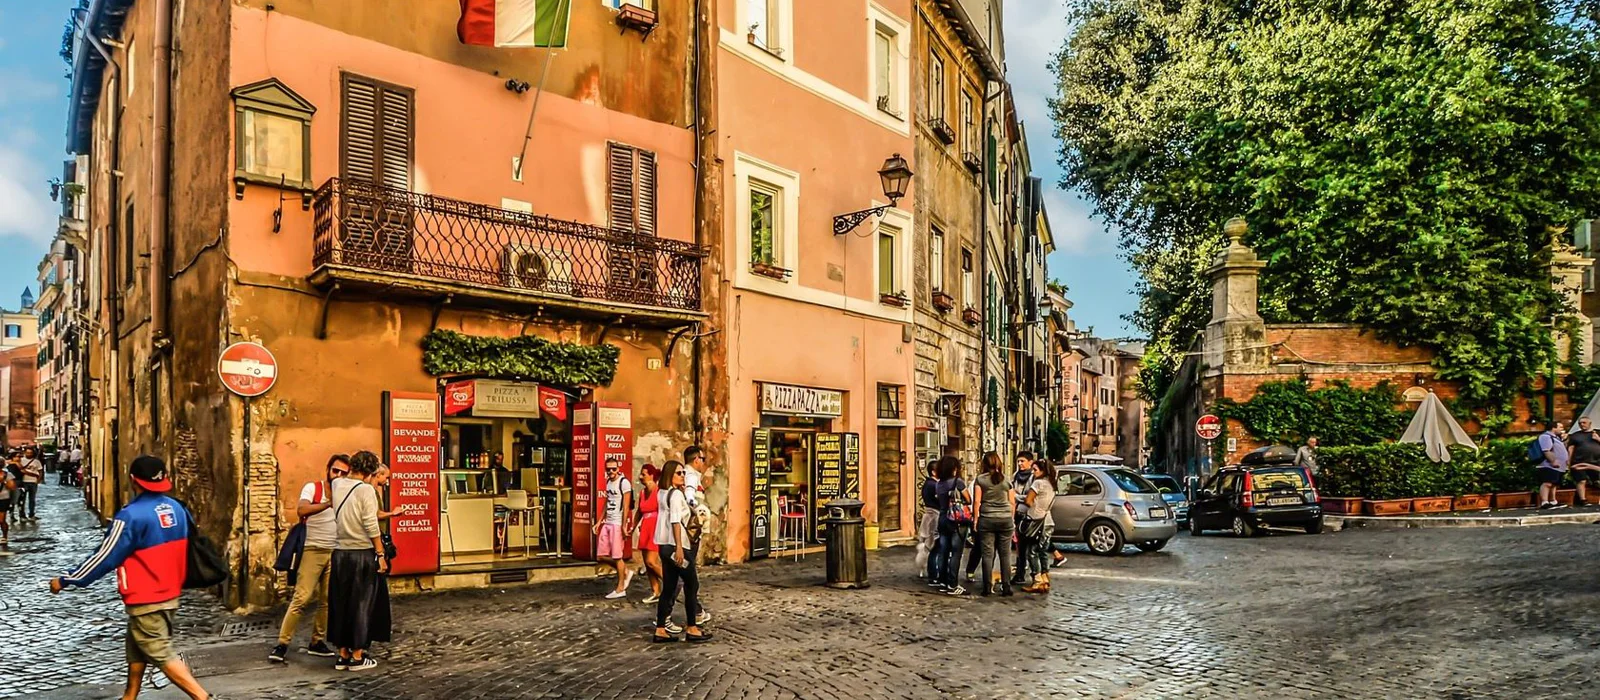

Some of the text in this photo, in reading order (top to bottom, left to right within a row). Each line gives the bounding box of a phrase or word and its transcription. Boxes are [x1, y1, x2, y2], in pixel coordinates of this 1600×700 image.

[494, 387, 519, 396] PIZZA
[486, 395, 527, 404] TRILUSSA
[774, 386, 820, 414] PIZZAPAZZA
[605, 434, 626, 442] PIZZA
